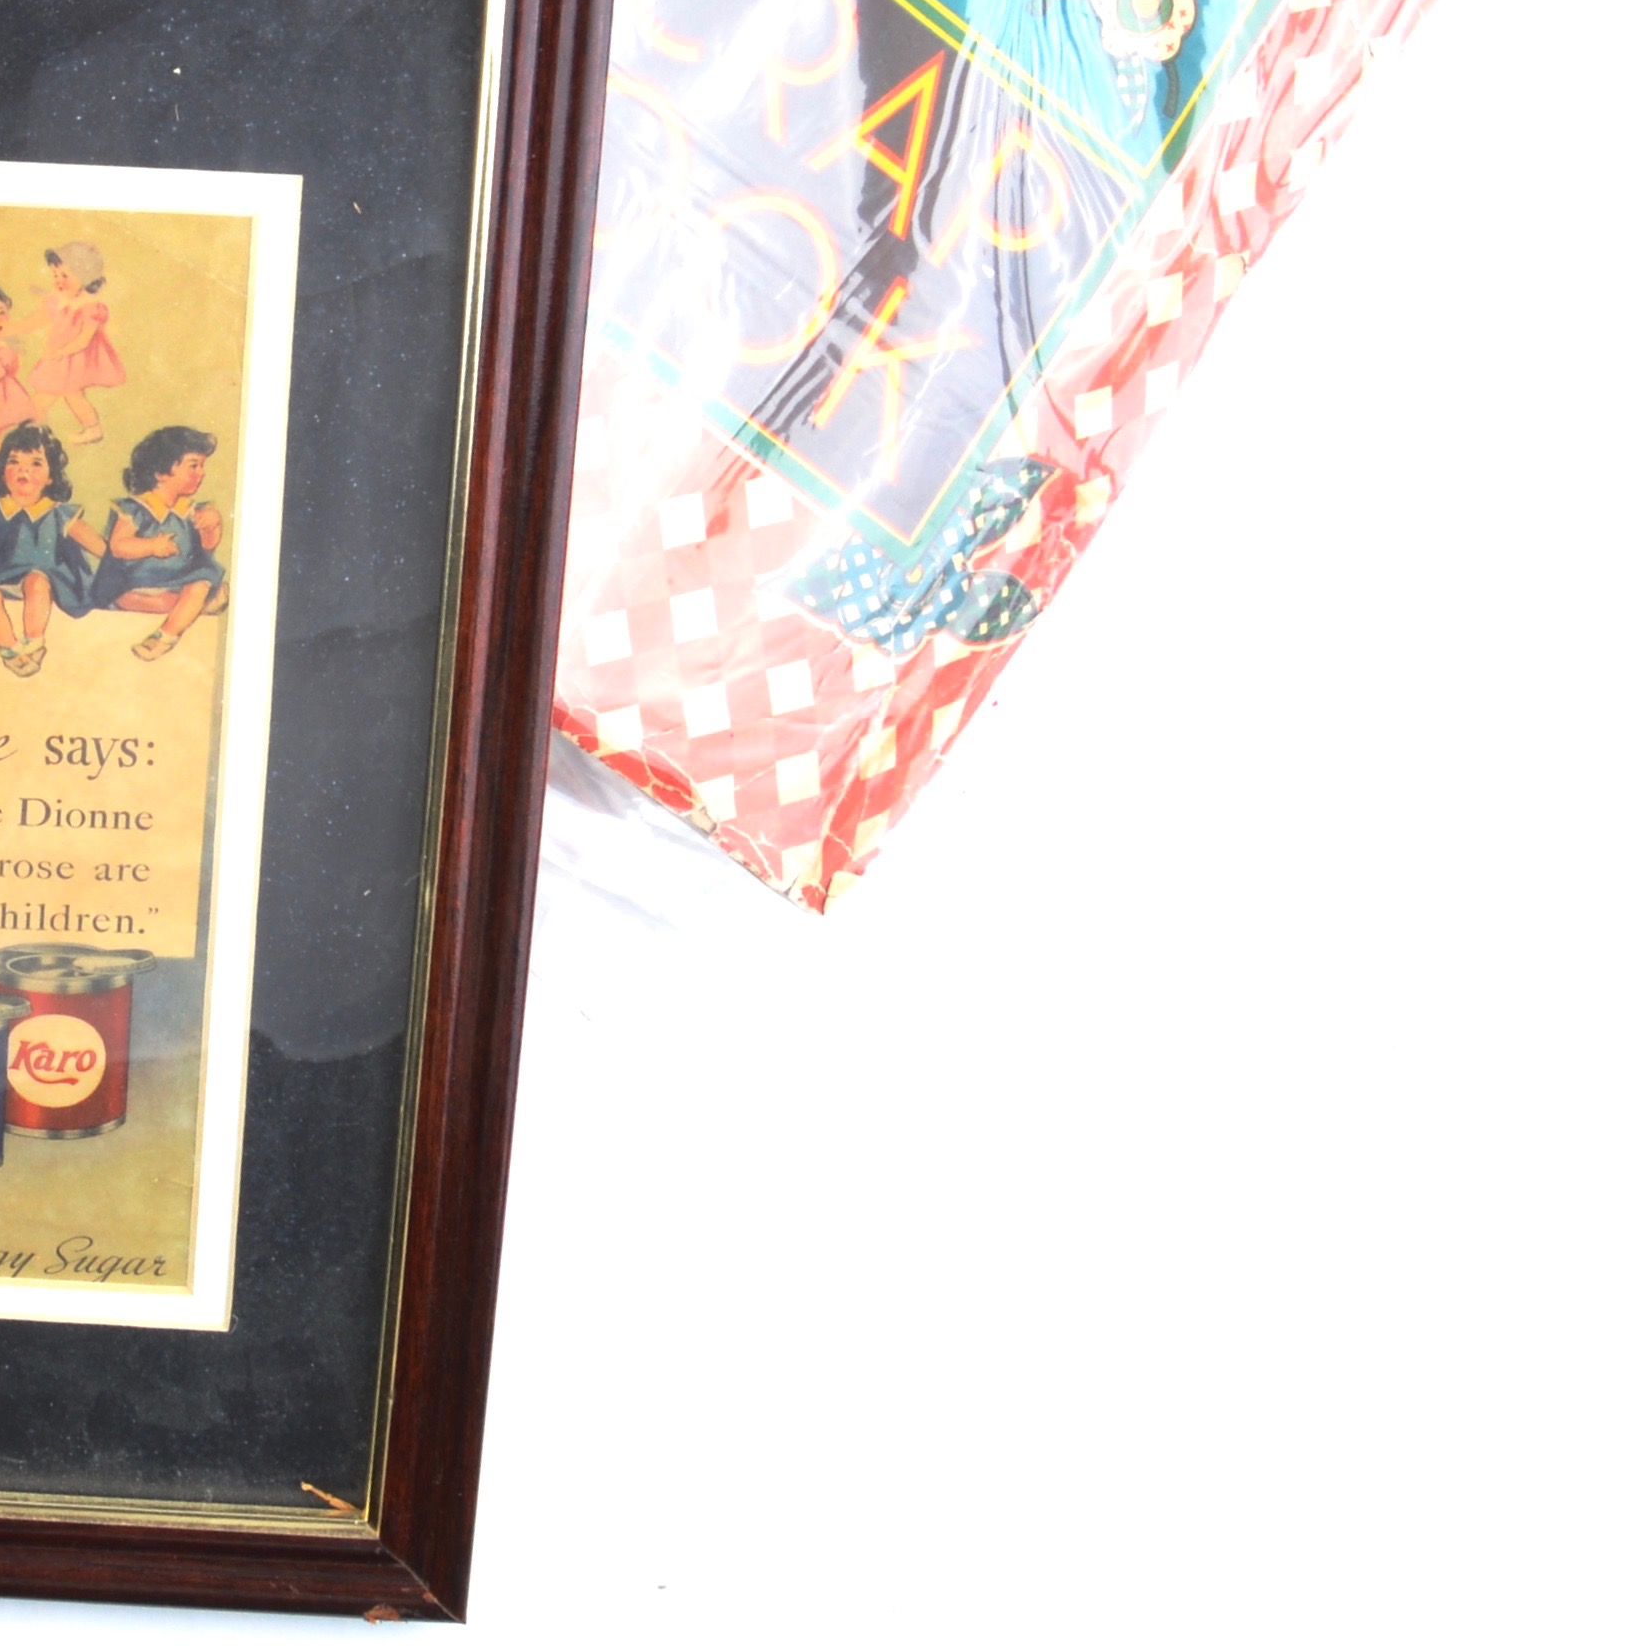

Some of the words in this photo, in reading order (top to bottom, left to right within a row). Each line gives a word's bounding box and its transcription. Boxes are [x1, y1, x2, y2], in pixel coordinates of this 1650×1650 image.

[44, 733, 156, 781] says:
[18, 796, 154, 832] Dionne
[93, 860, 151, 883] are
[7, 1039, 97, 1086] Karo
[44, 1235, 168, 1284] Sugar
